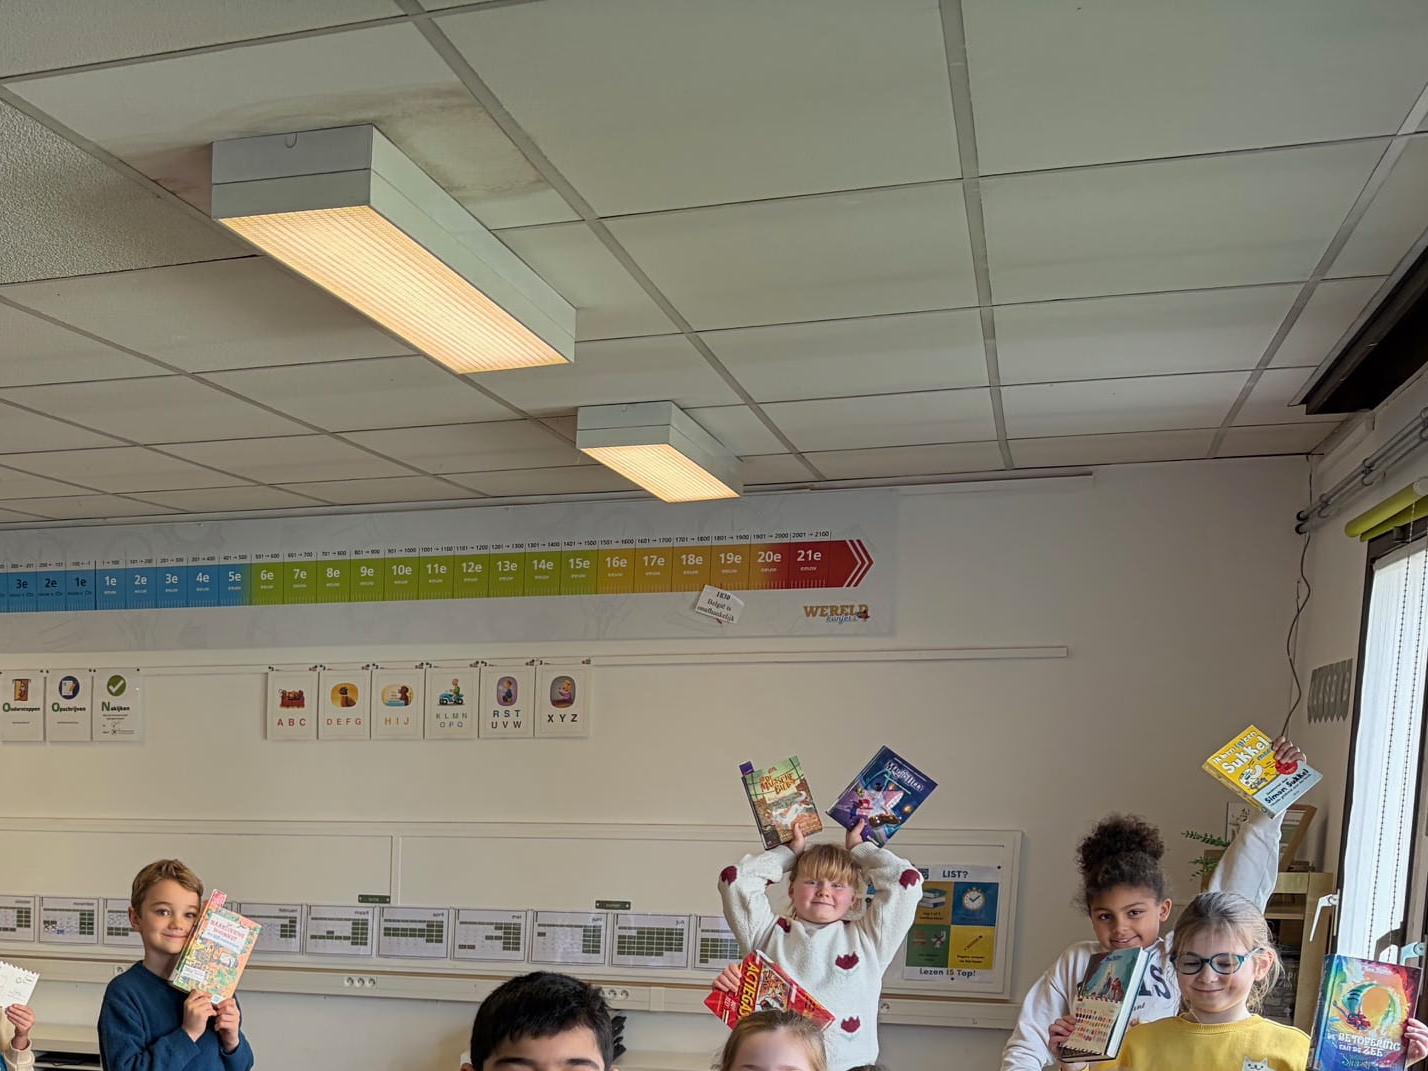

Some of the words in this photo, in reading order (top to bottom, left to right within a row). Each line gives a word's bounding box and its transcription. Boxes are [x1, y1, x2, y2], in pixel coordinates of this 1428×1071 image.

[681, 554, 703, 565] 18e
[720, 553, 742, 564] 19e
[758, 552, 782, 562] 20e
[797, 550, 822, 561] 21e
[497, 561, 518, 571] 13e
[532, 560, 554, 570] 14e
[569, 558, 590, 569] 15e
[606, 557, 627, 568] 16e
[643, 556, 665, 566] 17e
[360, 567, 374, 576] 9e
[392, 565, 412, 576] 10e
[426, 564, 447, 574] 11e
[462, 562, 482, 572] 12e
[196, 573, 210, 582] 4e
[228, 572, 241, 581] 5e
[261, 570, 274, 580] 6e
[294, 569, 307, 579] 7e
[327, 568, 340, 578] 8e
[45, 578, 57, 588] 2e
[76, 578, 86, 586] 1e
[105, 576, 116, 586] 1e
[135, 575, 147, 584] 2e
[166, 574, 178, 583] 3e
[16, 580, 28, 588] 3e
[804, 604, 869, 617] WERELD
[52, 702, 86, 713] Opschrijven
[101, 701, 130, 713] Nakijken
[1222, 735, 1271, 774] Sukkel
[1286, 768, 1309, 787] Sukkel
[942, 870, 969, 879] LIST?
[919, 968, 943, 976] Lezen
[957, 969, 976, 979] Top!
[738, 963, 759, 1018] ACTIEGA
[1338, 1033, 1401, 1051] BETOVERING
[1362, 1047, 1384, 1057] ZEE
